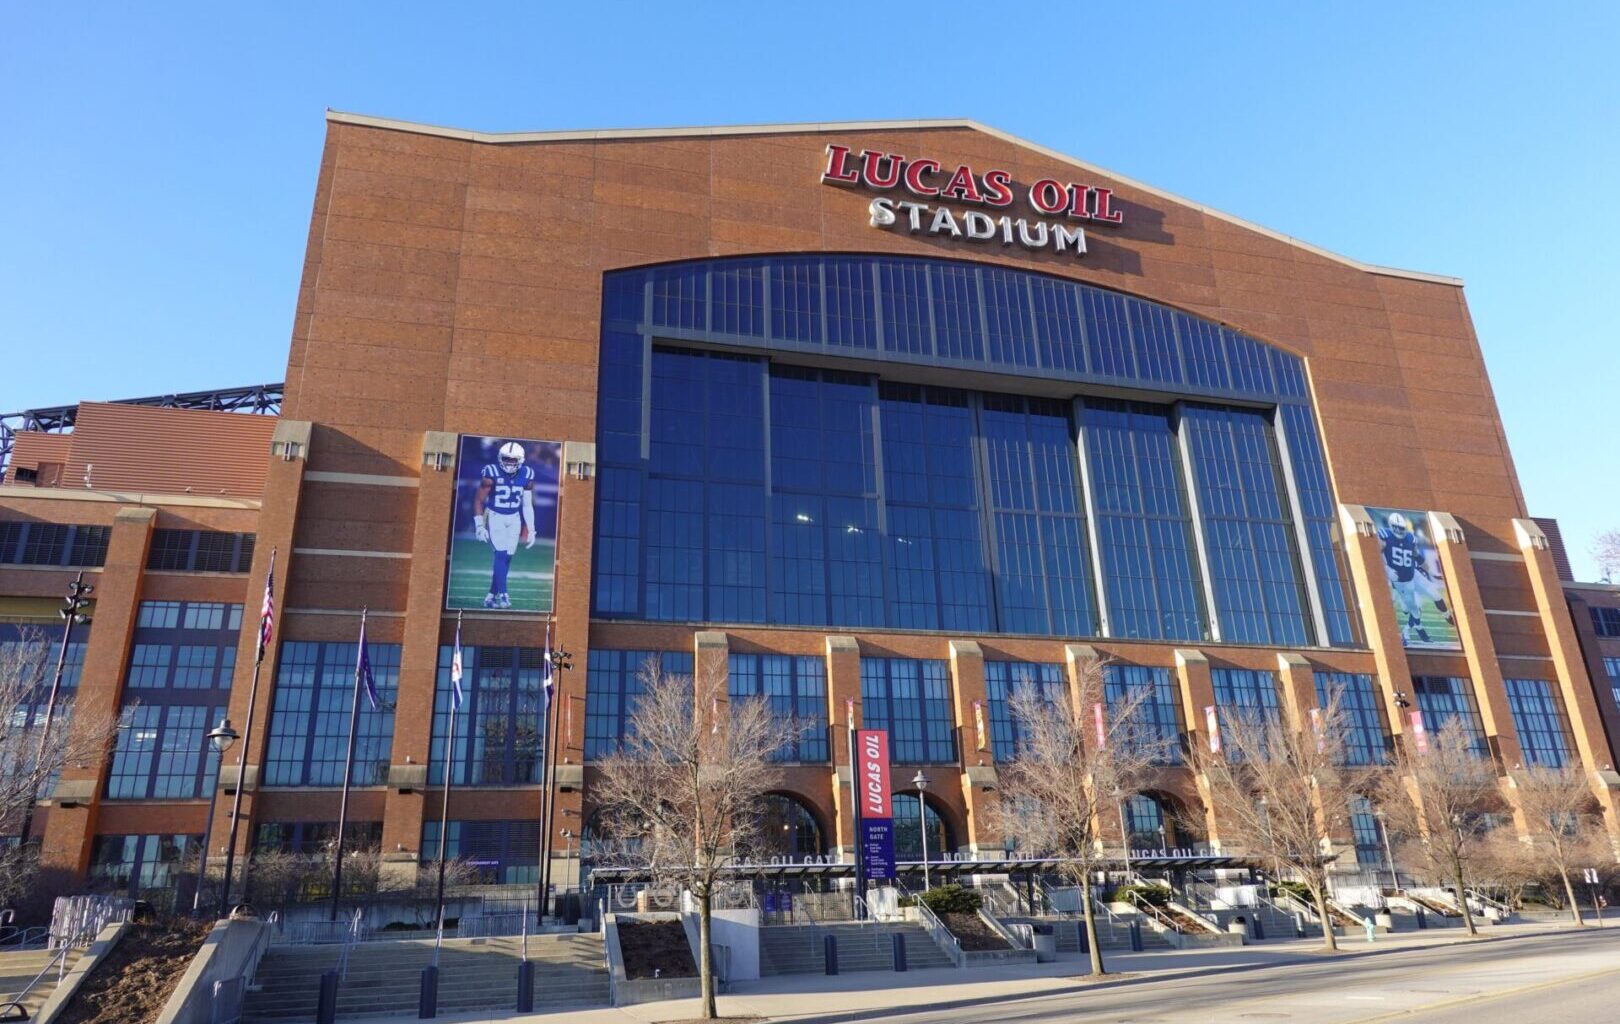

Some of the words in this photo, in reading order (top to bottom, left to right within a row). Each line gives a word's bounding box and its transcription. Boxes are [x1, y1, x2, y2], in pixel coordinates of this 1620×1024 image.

[821, 143, 1013, 207] LUCAS
[1029, 178, 1123, 224] OIL
[869, 197, 1088, 258] STADIUM
[494, 485, 524, 509] 23
[1391, 546, 1413, 568] 56
[866, 735, 880, 759] OIL
[867, 762, 883, 814] LUCAS
[1130, 848, 1167, 858] UCAS
